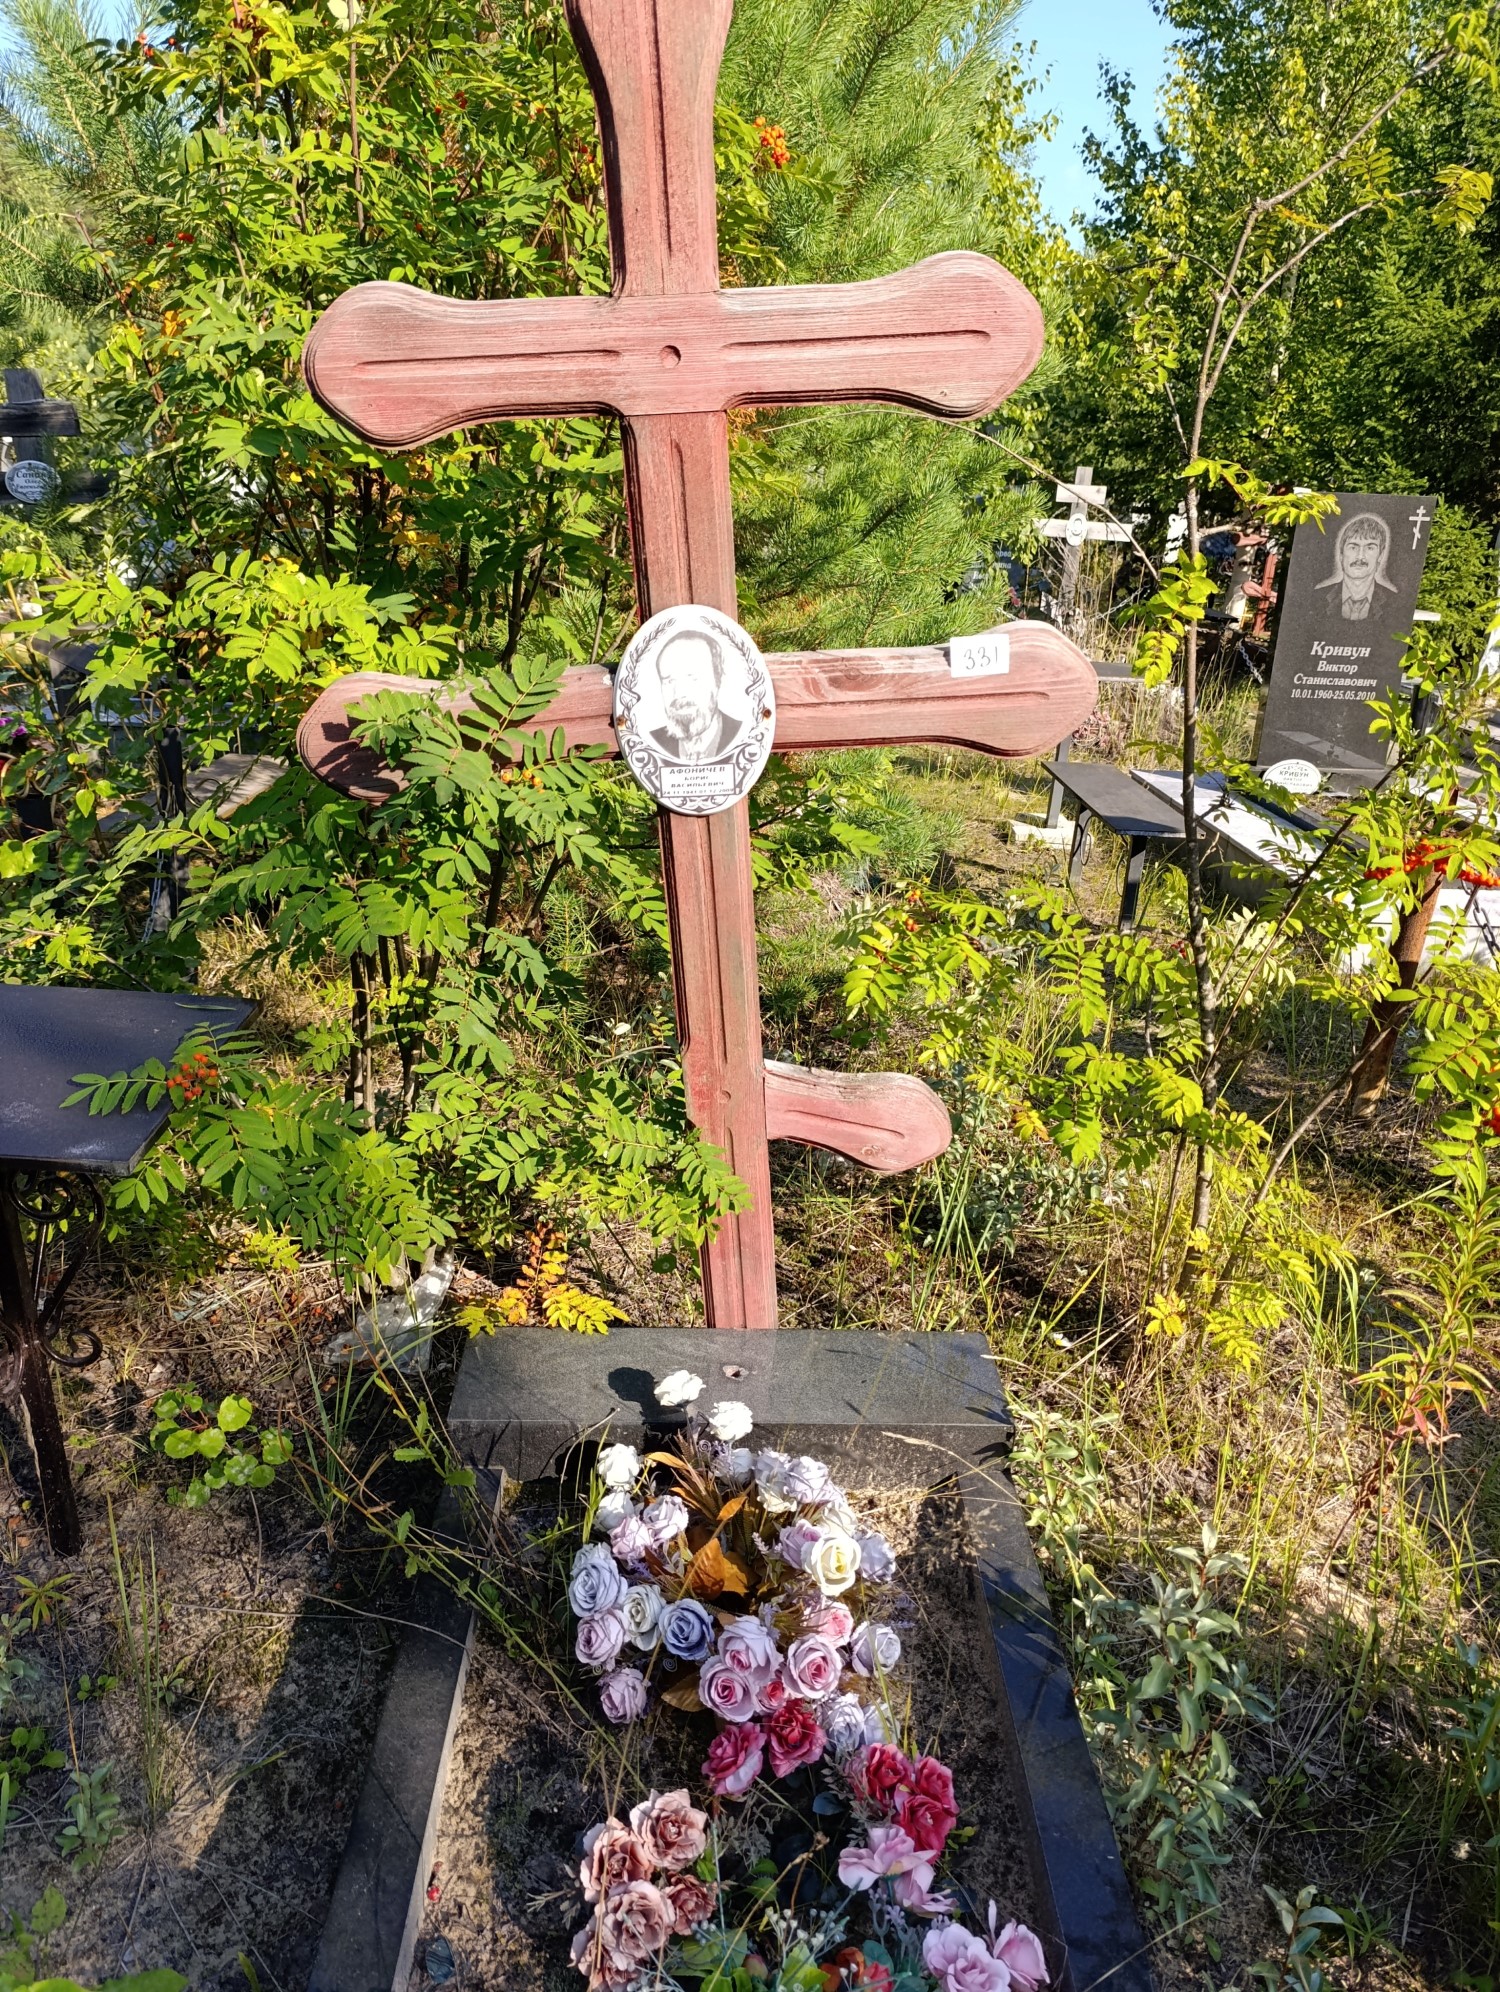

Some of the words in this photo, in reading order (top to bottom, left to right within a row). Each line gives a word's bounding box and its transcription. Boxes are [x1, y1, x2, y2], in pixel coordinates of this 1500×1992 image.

[964, 646, 998, 670] 331
[1310, 641, 1371, 660] Кривун
[1316, 660, 1358, 675] Виктор
[1293, 673, 1377, 687] Станиславович
[669, 766, 725, 775] АФОНИЧЕВ
